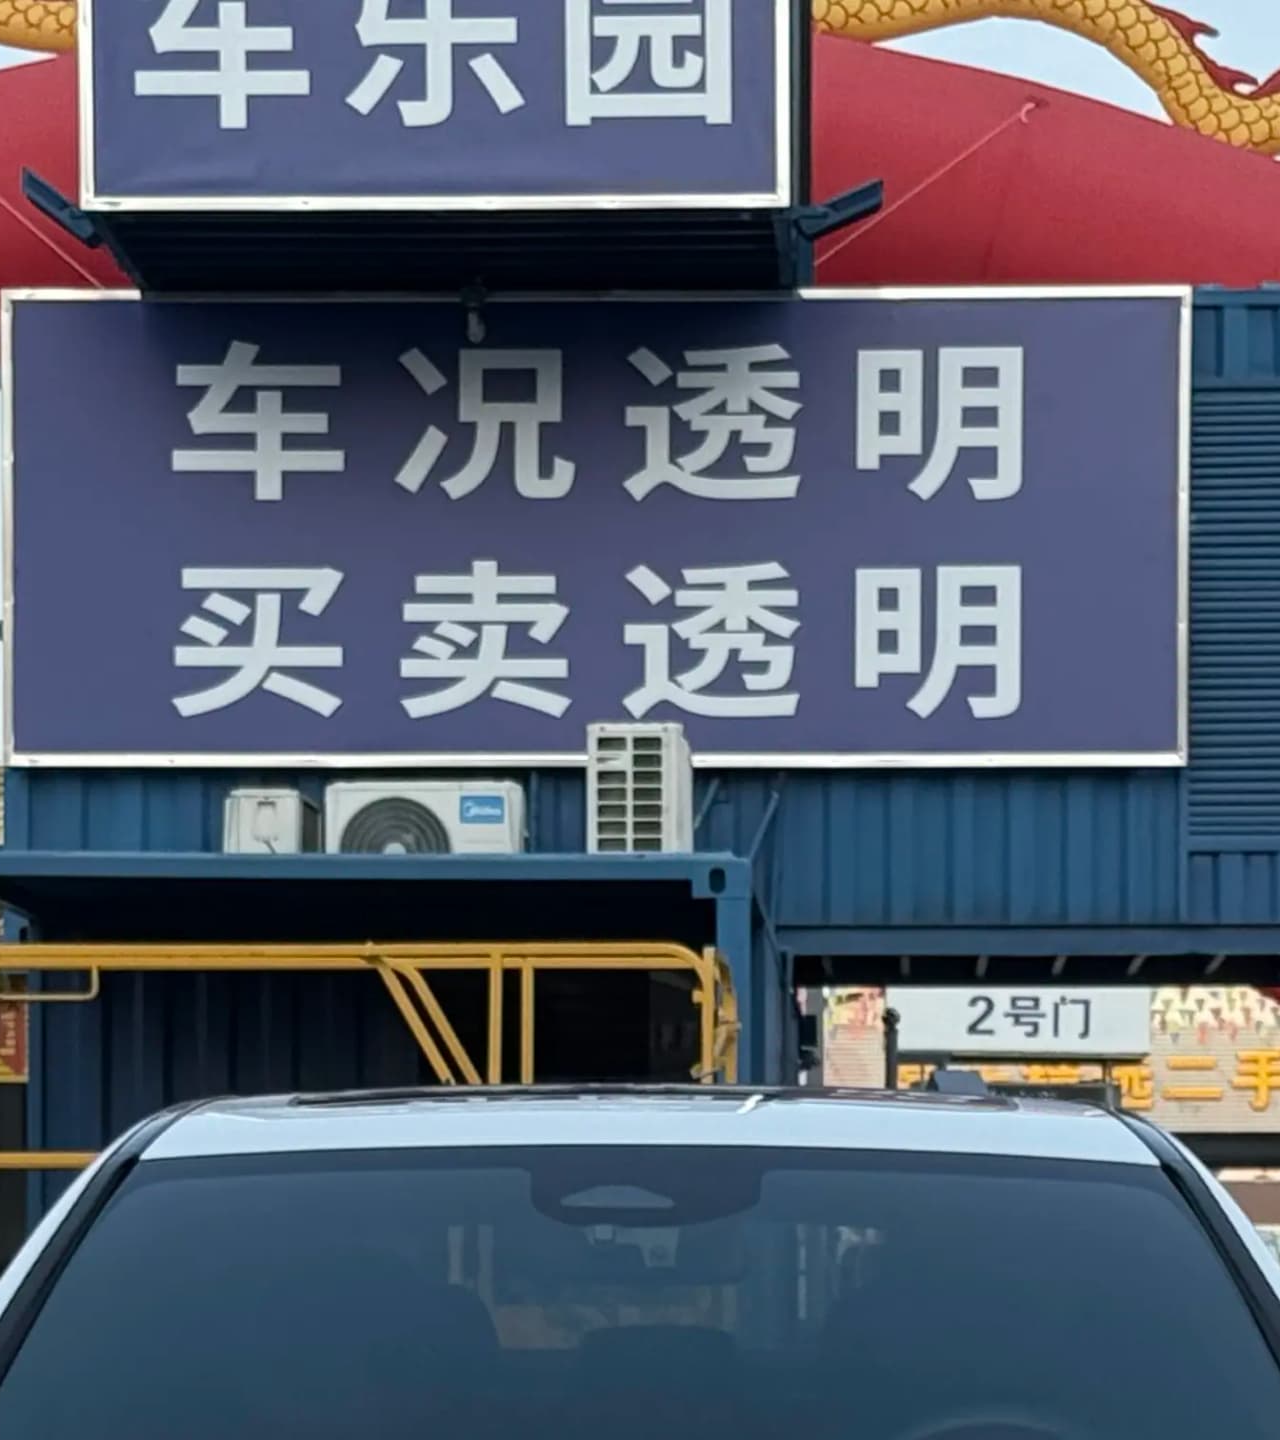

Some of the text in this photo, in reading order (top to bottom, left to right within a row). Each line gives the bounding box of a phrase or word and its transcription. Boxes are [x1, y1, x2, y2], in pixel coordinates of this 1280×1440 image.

[171, 340, 1025, 501] 车况透明
[172, 560, 1024, 720] 买卖透明
[966, 994, 1092, 1039] 2号门
